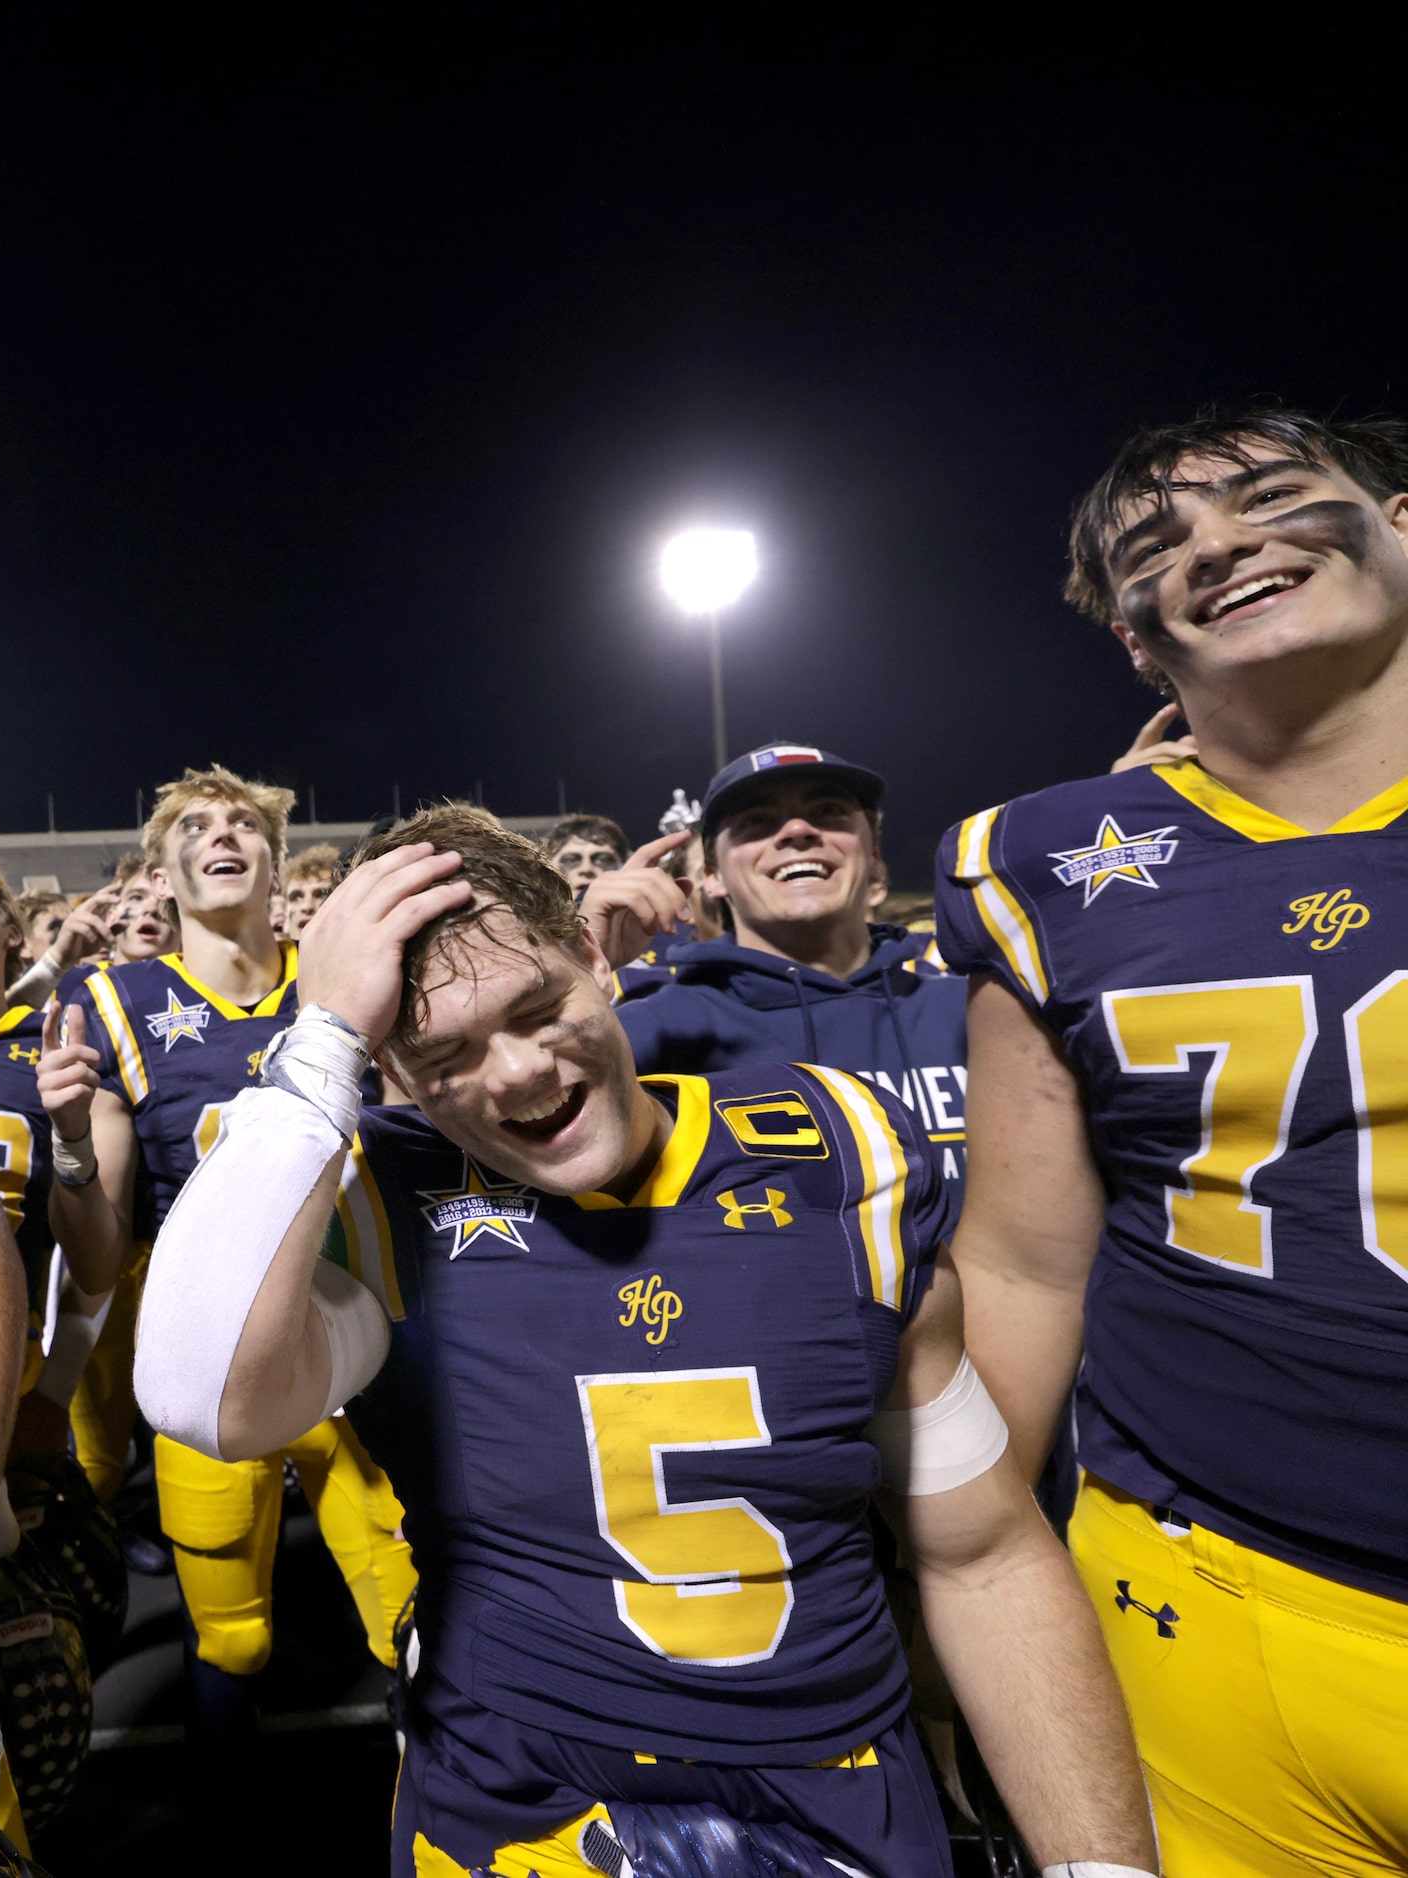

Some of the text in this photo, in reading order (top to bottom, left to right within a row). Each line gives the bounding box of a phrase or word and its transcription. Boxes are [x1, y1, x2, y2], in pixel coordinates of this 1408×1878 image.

[1281, 888, 1371, 951] HP
[723, 1104, 821, 1148] C
[470, 1207, 493, 1217] 2017
[501, 1206, 527, 1217] 2018
[498, 1197, 525, 1208] 2005
[617, 1274, 683, 1345] HP
[574, 1365, 794, 1668] 5
